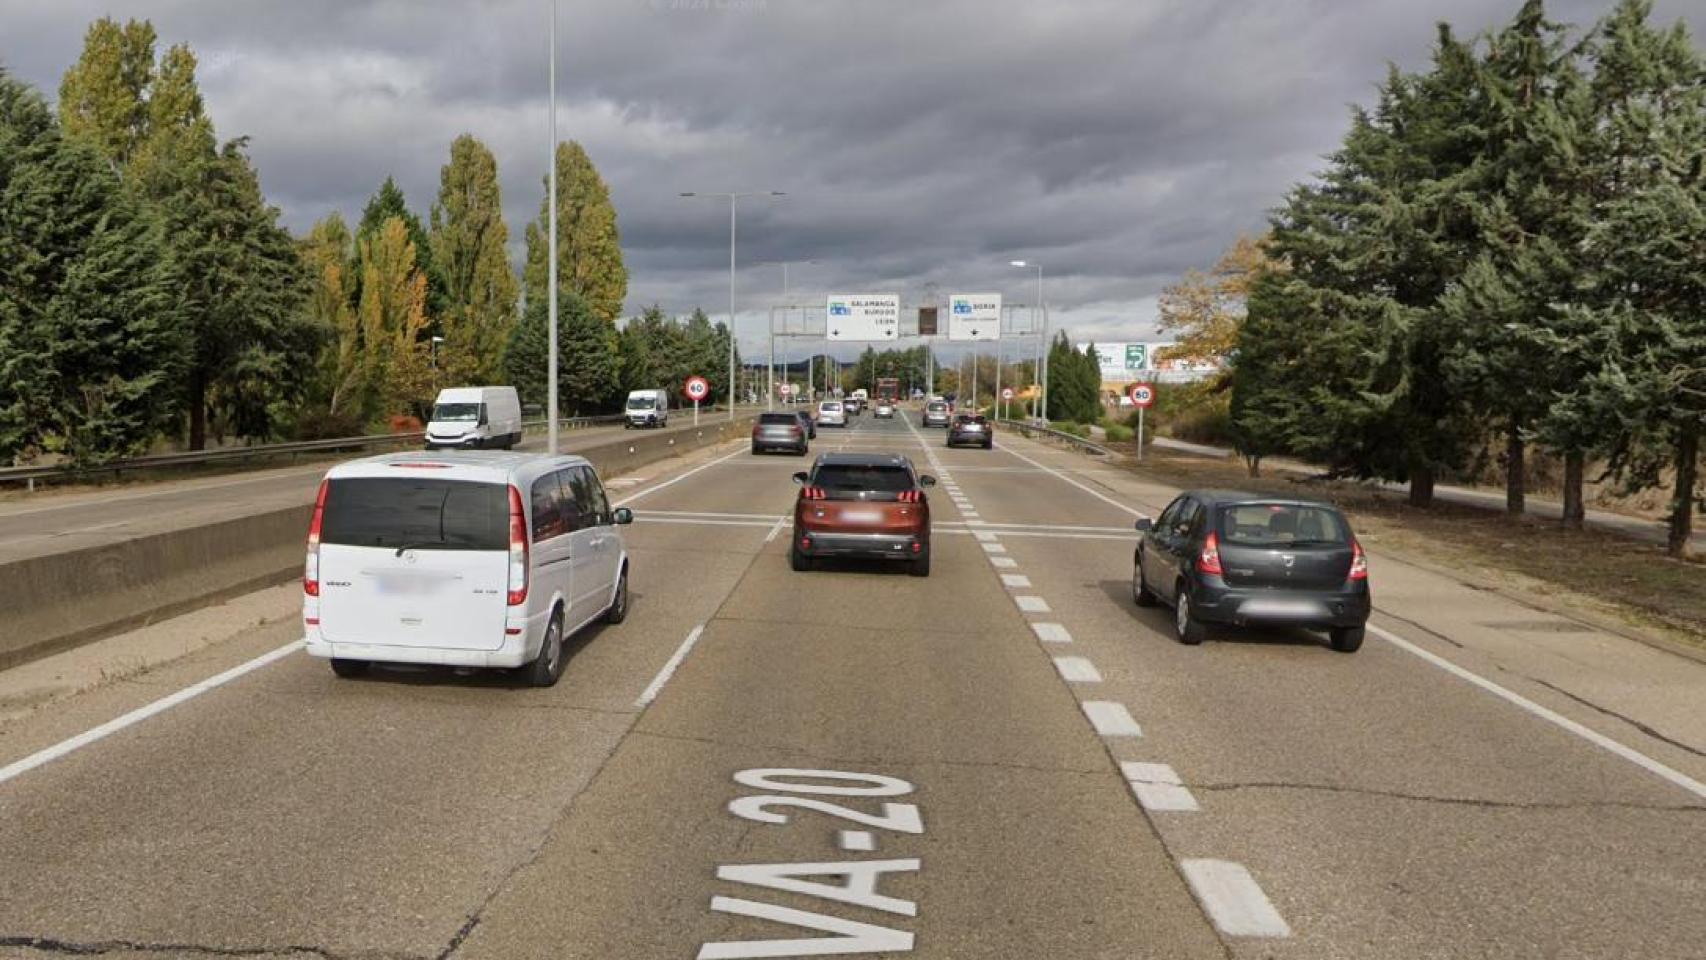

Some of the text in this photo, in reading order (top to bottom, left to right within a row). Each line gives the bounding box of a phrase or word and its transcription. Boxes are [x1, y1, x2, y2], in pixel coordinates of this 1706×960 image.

[690, 384, 703, 392] 60
[1136, 390, 1148, 398] 60
[697, 767, 924, 960] VA-20
